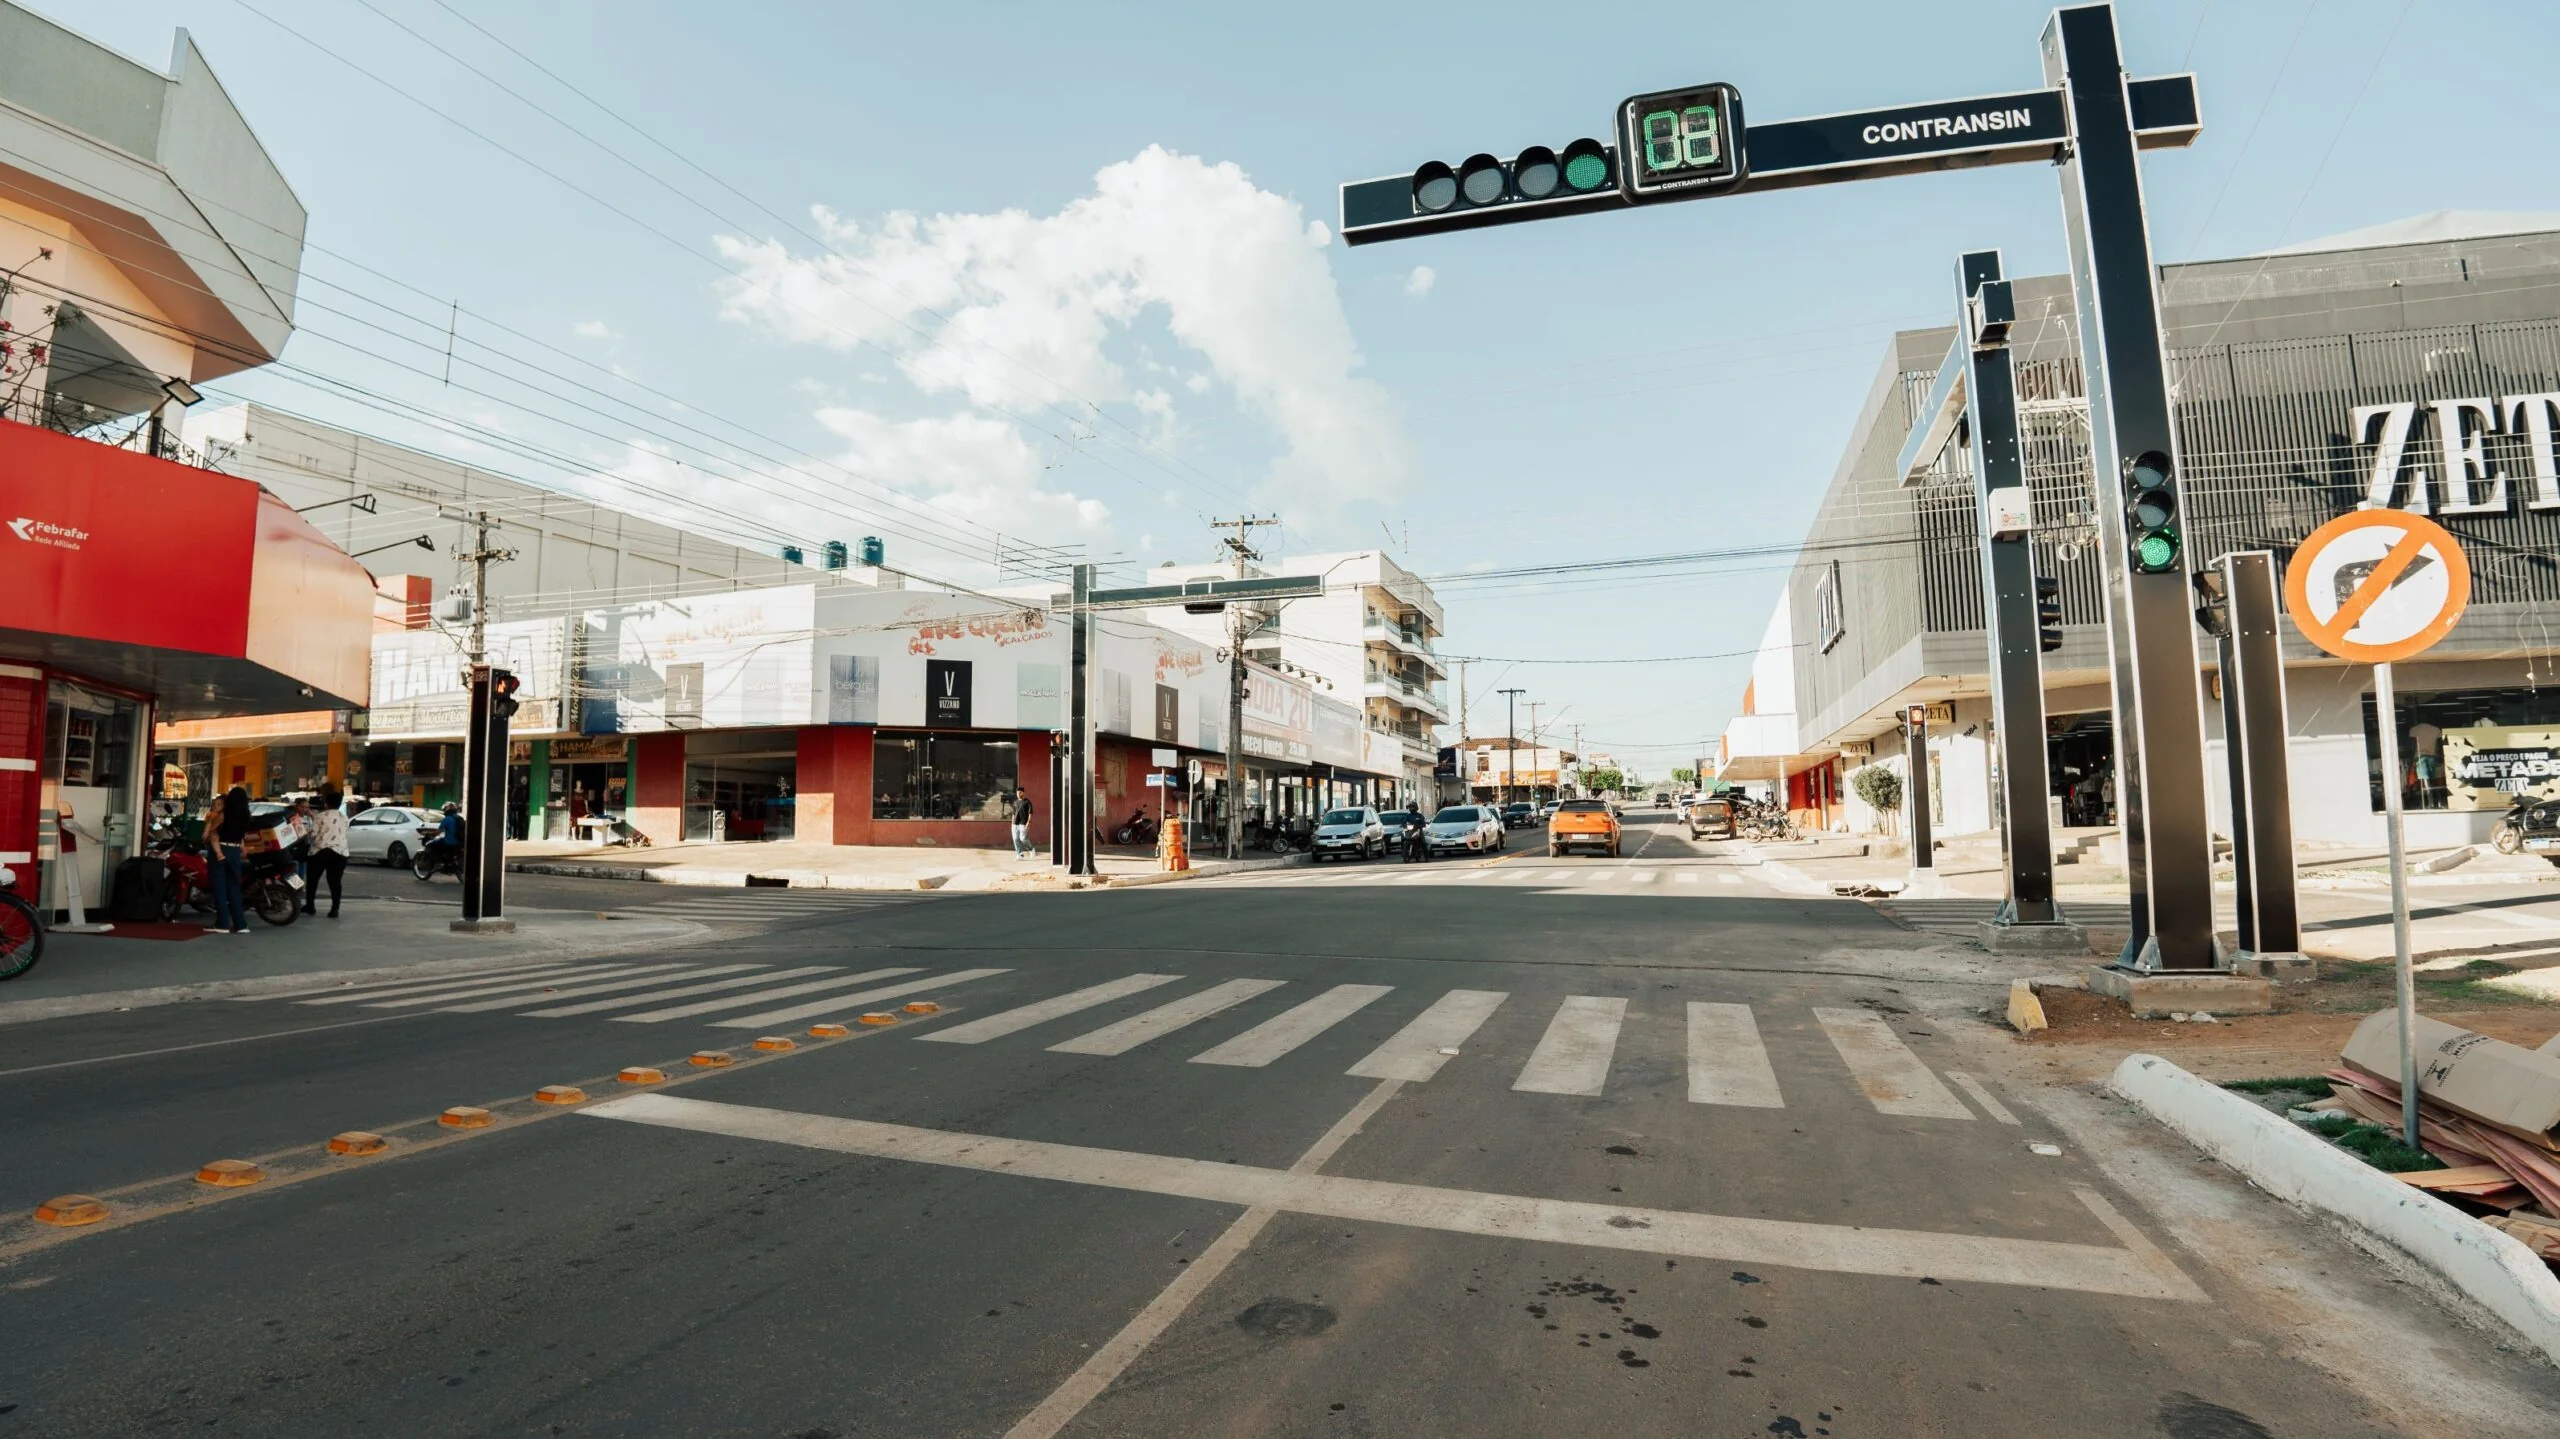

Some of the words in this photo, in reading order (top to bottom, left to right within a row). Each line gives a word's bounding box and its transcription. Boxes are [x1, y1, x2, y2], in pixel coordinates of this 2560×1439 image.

[1862, 108, 2033, 145] CONTRANSIN
[1662, 177, 1710, 189] CONTRANSIN
[36, 522, 89, 541] Febrafar
[34, 535, 52, 545] Rede
[53, 539, 81, 551] Afiliada
[1004, 631, 1053, 645] CALÇADOS
[943, 671, 955, 696] V
[1288, 686, 1310, 730] 20
[1925, 707, 1950, 720] ZETA
[1241, 735, 1263, 757] PREÇO
[1263, 737, 1284, 758] ÚNICO
[1849, 743, 1870, 754] ZETA
[2470, 753, 2489, 762] VEJA
[2489, 753, 2495, 762] O
[2496, 753, 2519, 763] PREÇO
[2520, 752, 2525, 760] E
[2525, 751, 2549, 761] PAGUE
